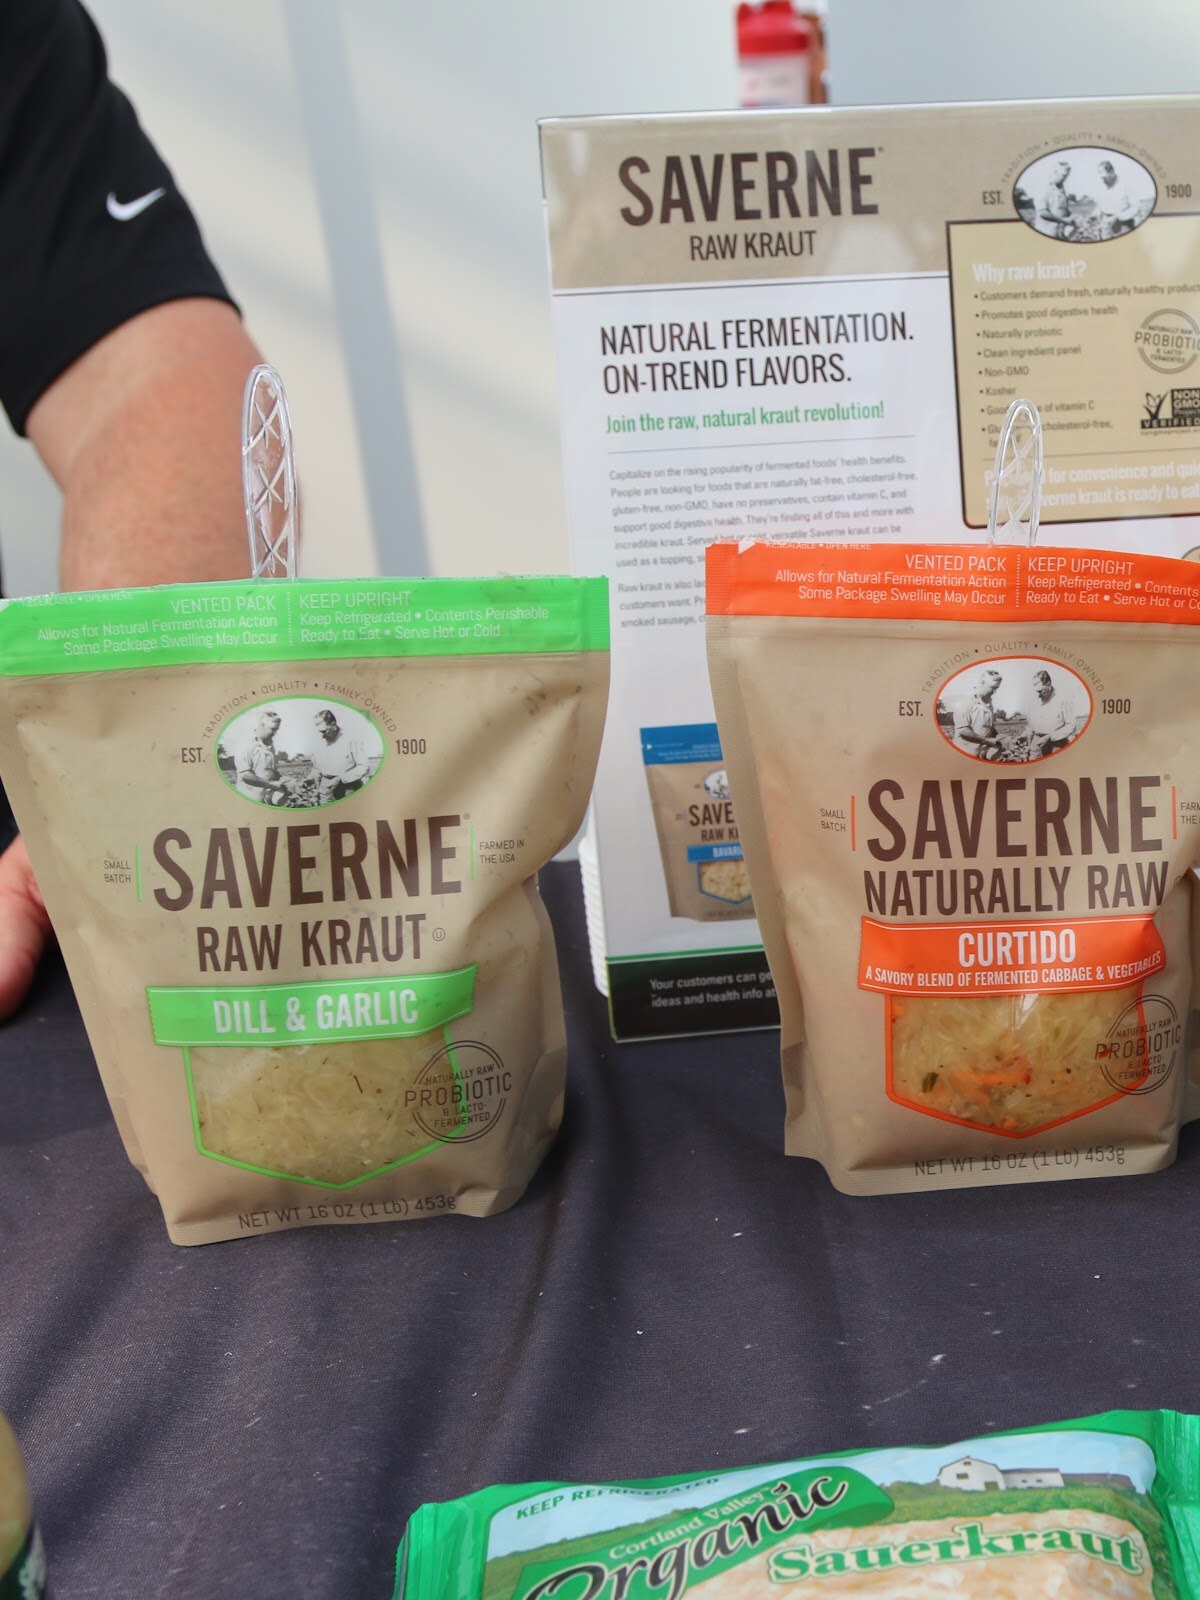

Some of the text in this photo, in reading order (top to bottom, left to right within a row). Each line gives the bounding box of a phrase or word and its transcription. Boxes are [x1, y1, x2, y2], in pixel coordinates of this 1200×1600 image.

[618, 147, 879, 227] SAVERNE
[982, 184, 1192, 205] EST. 1900
[689, 231, 816, 261] RAW KRAUT
[973, 261, 1086, 284] Why raw kraut?
[981, 290, 1027, 301] Customers
[1030, 288, 1064, 299] demand
[1067, 287, 1091, 298] fresh,
[1094, 285, 1131, 296] naturally
[1134, 284, 1164, 295] healthy
[982, 305, 1118, 321] Promotes good digestive health
[601, 312, 913, 355] NATURAL FERMENTATION.
[603, 354, 851, 394] ON-TREND FLAVORS.
[1172, 389, 1200, 400] NON
[1173, 399, 1200, 409] GMO
[606, 401, 884, 433] Join the raw, natural kraut revolution!
[905, 555, 1006, 572] VENTED PACK
[1028, 557, 1135, 576] KEEP UPRIGHT
[775, 570, 1006, 588] Allows for Natural Fermentation Action
[1027, 576, 1056, 589] Keep
[1059, 576, 1131, 592] Refrigerated
[1145, 581, 1200, 597] Contents
[171, 595, 276, 614] VENTED PACK
[300, 591, 411, 609] KEEP UPRIGHT
[798, 586, 1006, 606] Some Package Swelling May Occur
[1026, 591, 1061, 606] Ready
[1064, 593, 1076, 604] to
[1079, 593, 1100, 604] Eat
[1113, 593, 1146, 606] Serve
[1150, 594, 1170, 607] Hot
[1174, 598, 1186, 608] or
[899, 699, 1131, 717] EST. 1900
[181, 738, 426, 762] EST. 1900
[867, 775, 1163, 862] SAVERNE
[480, 838, 524, 851] FARMED IN
[104, 860, 130, 871] SMALL
[152, 814, 462, 912] SAVERNE
[480, 853, 516, 865] THE USA
[104, 873, 131, 883] BATCH
[864, 861, 1169, 916] NATURALLY RAW
[196, 913, 426, 972] RAW KRAUT
[958, 928, 1076, 968] CURTIDO
[865, 951, 1161, 987] A SAVORY BLEND OF FERMENTED CABBAGE & VEGETABLES
[650, 972, 757, 990] Your customers can
[652, 987, 776, 1007] ideas and health info at
[213, 988, 418, 1034] DILL & GARLIC
[1094, 1025, 1181, 1060] PROBIOTIC
[404, 1072, 513, 1108] PROBIOTIC
[238, 1195, 456, 1230] NET WT 16 OZ (1 Lb) 453g
[516, 1477, 720, 1519] KEEP REFRIGERATED
[609, 1486, 765, 1561] Cortland Valley
[520, 1473, 849, 1600] Organic
[769, 1524, 1143, 1583] Sauerkraut
